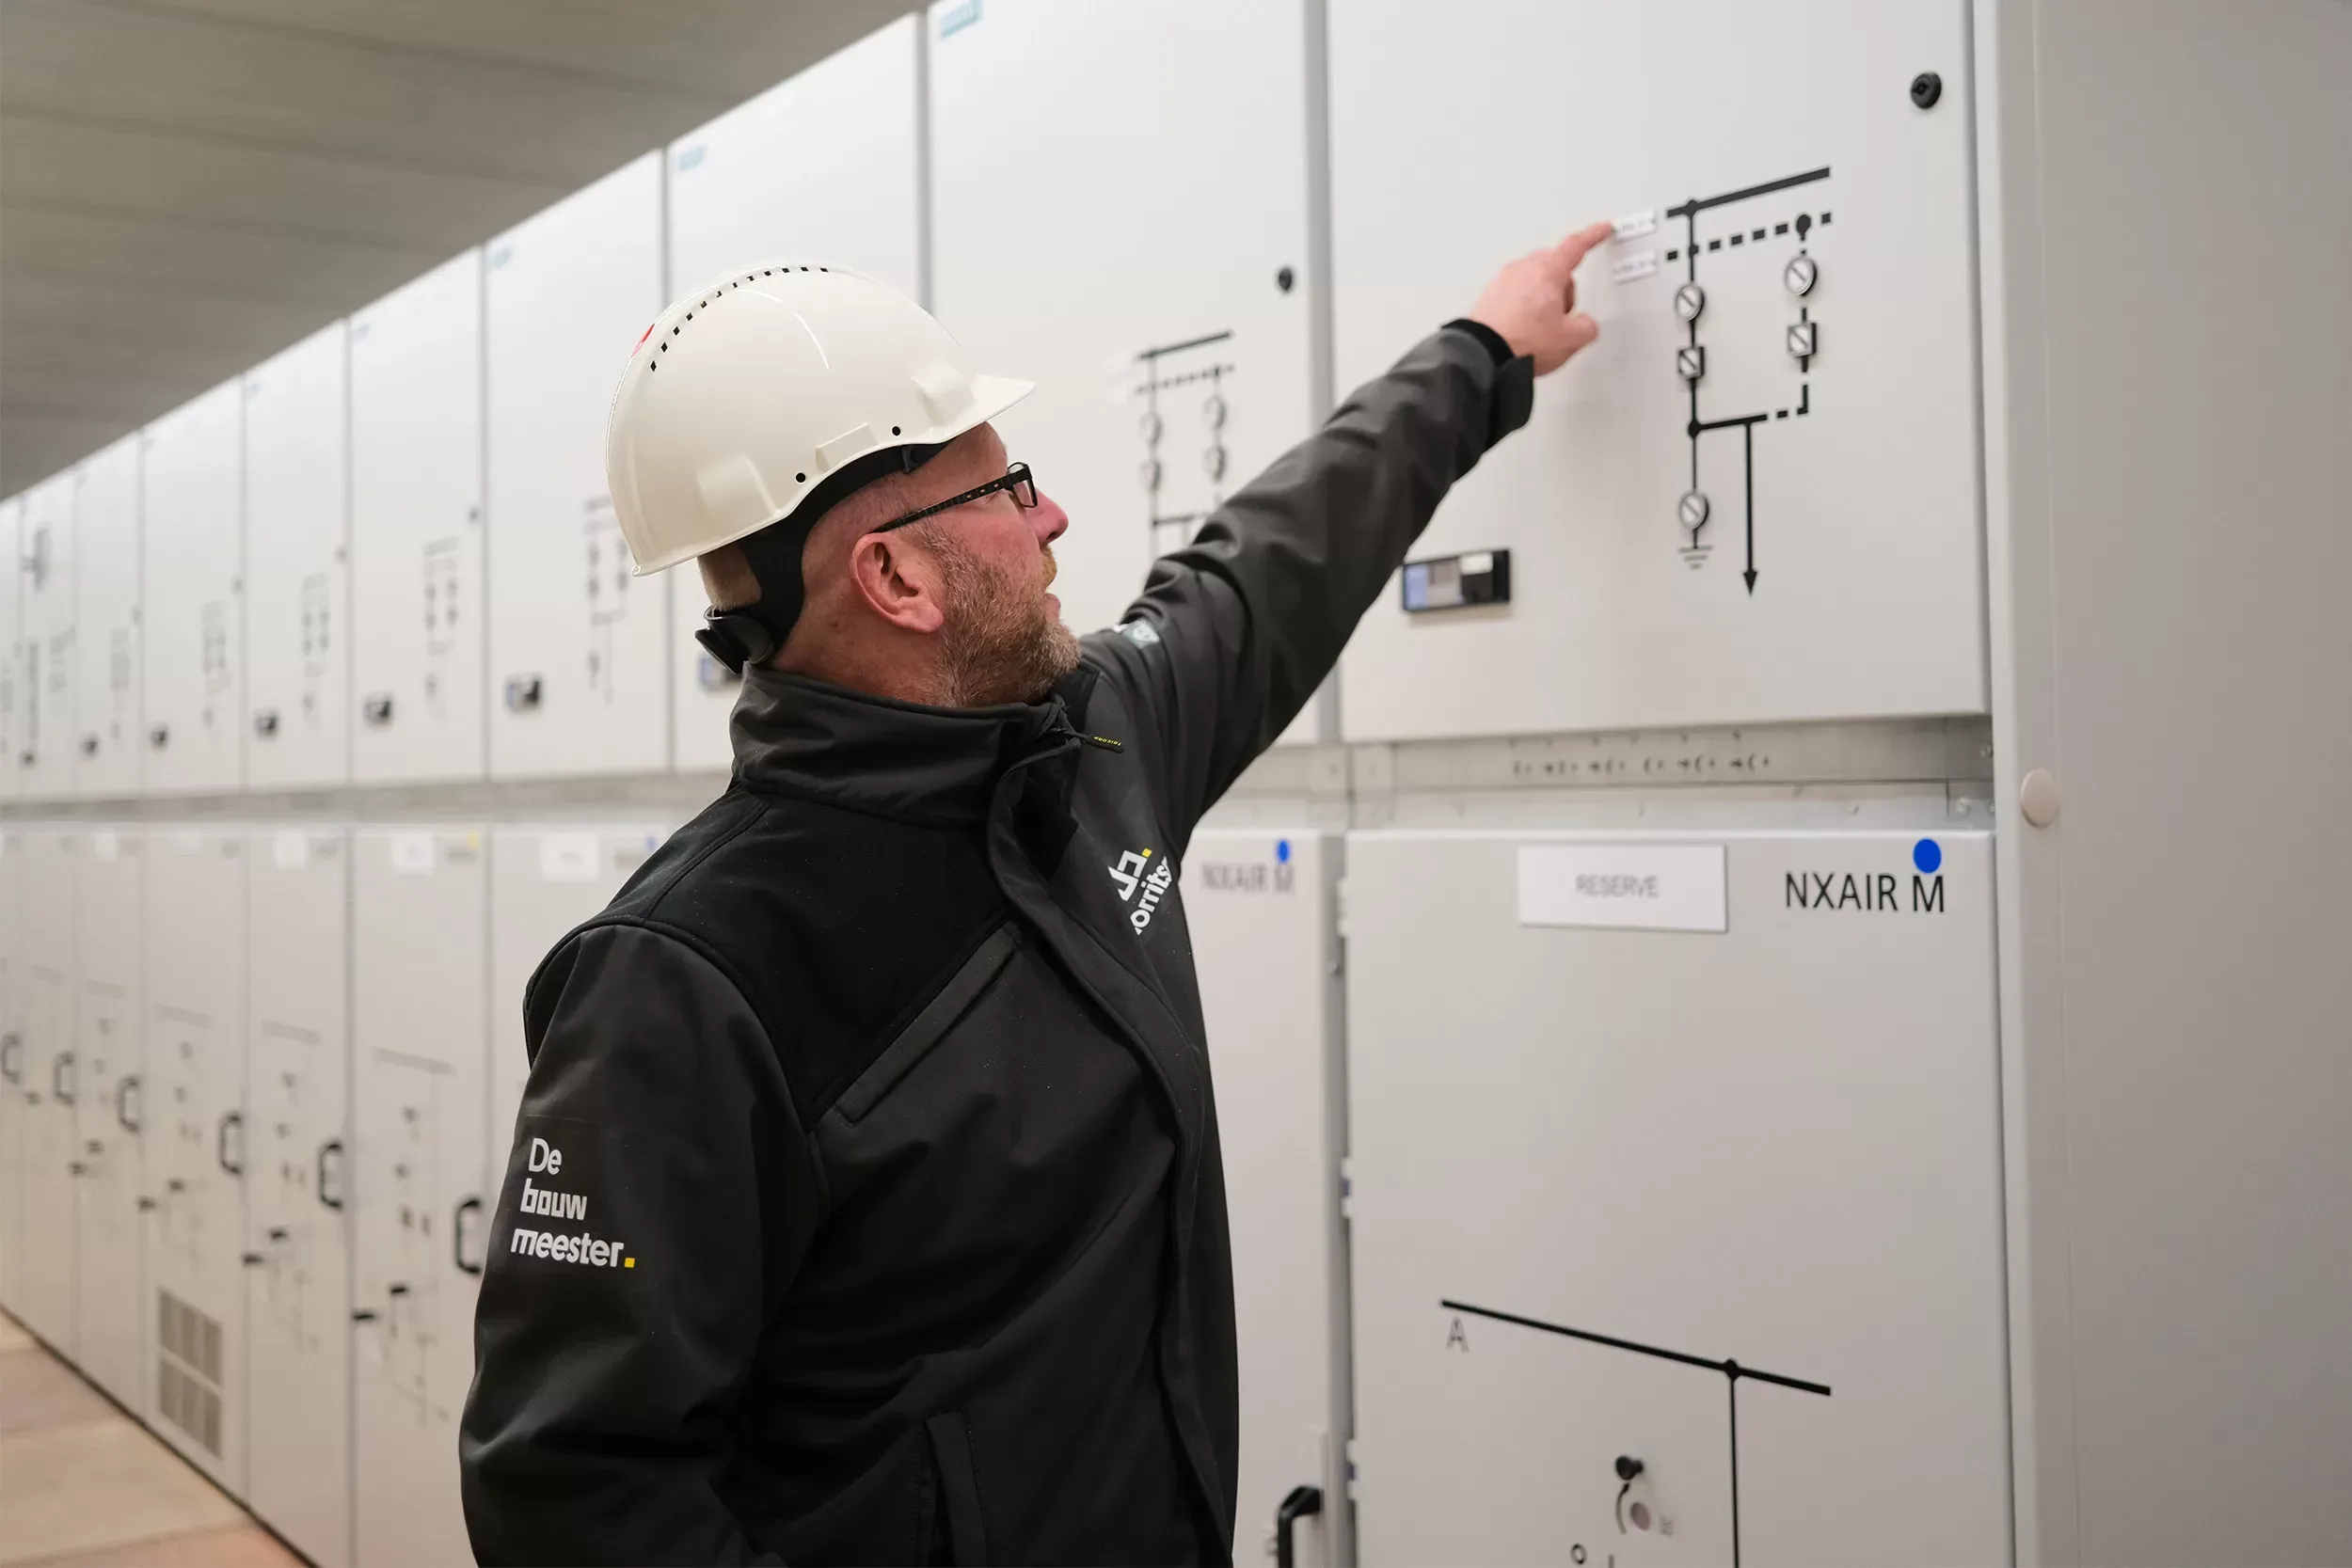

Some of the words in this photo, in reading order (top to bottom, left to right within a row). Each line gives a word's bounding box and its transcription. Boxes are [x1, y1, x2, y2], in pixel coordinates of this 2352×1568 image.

[1130, 856, 1172, 935] orrits
[1575, 874, 1660, 899] RESERVE
[1786, 873, 1899, 911] NXAIR
[1913, 875, 1945, 912] M
[529, 1137, 563, 1175] De
[519, 1178, 588, 1221] bouw
[1446, 1318, 1470, 1353] A
